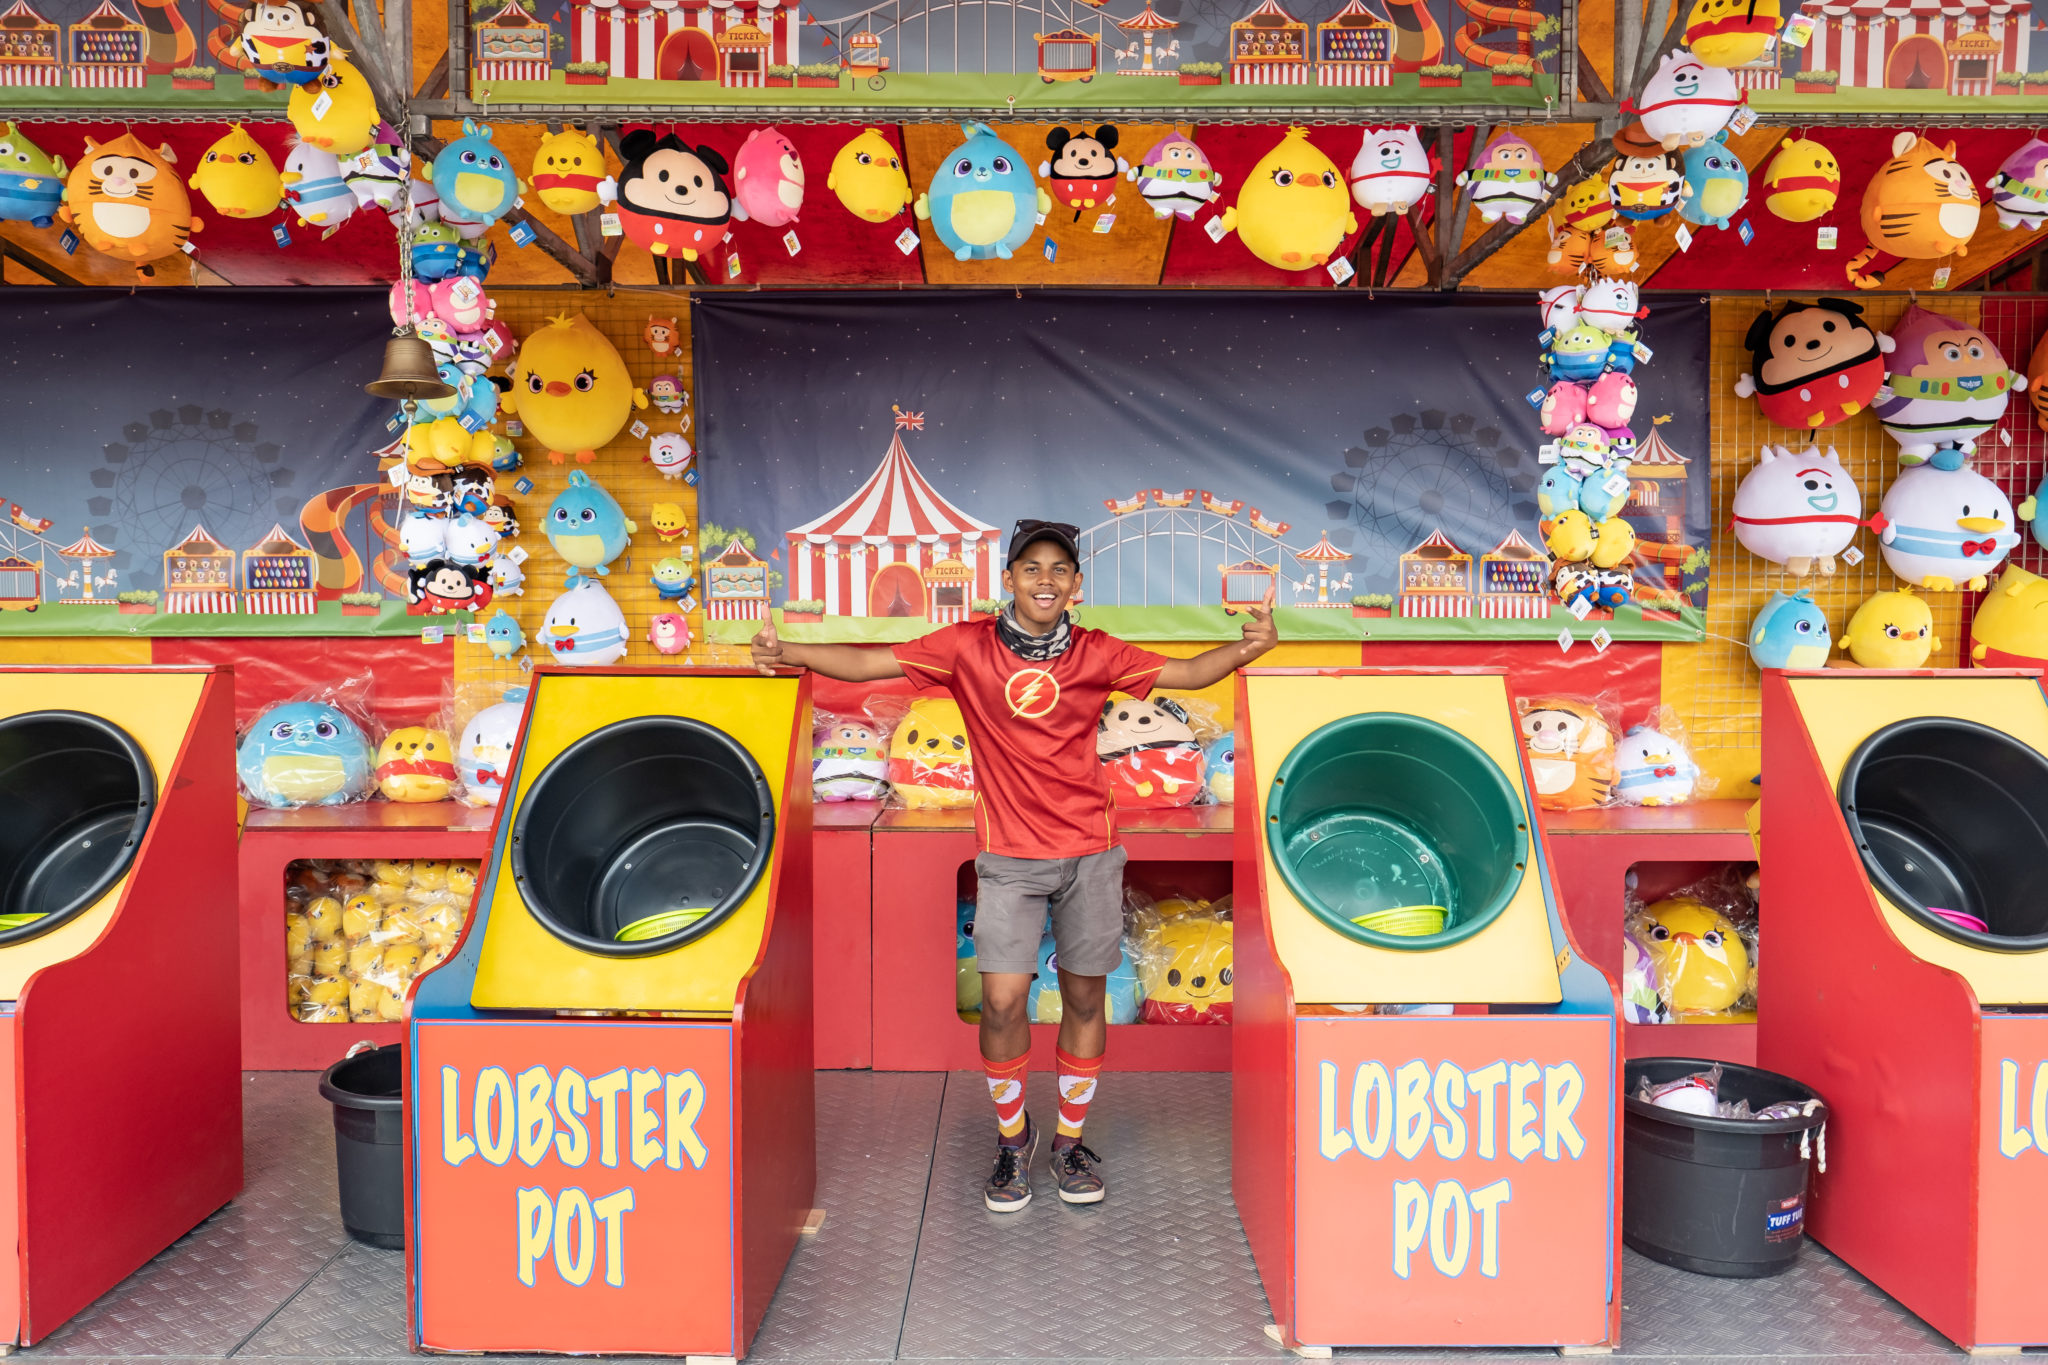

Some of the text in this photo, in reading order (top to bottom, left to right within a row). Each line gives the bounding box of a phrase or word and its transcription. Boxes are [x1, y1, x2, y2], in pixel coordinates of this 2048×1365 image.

[728, 32, 760, 41] TICKET
[1960, 39, 1991, 48] TICKET
[935, 567, 964, 575] TICKET
[440, 1064, 709, 1171] LOBSTER
[1318, 1058, 1587, 1163] LOBSTER
[516, 1185, 635, 1288] POT
[1392, 1177, 1512, 1280] POT
[1770, 1214, 1791, 1227] TUFF
